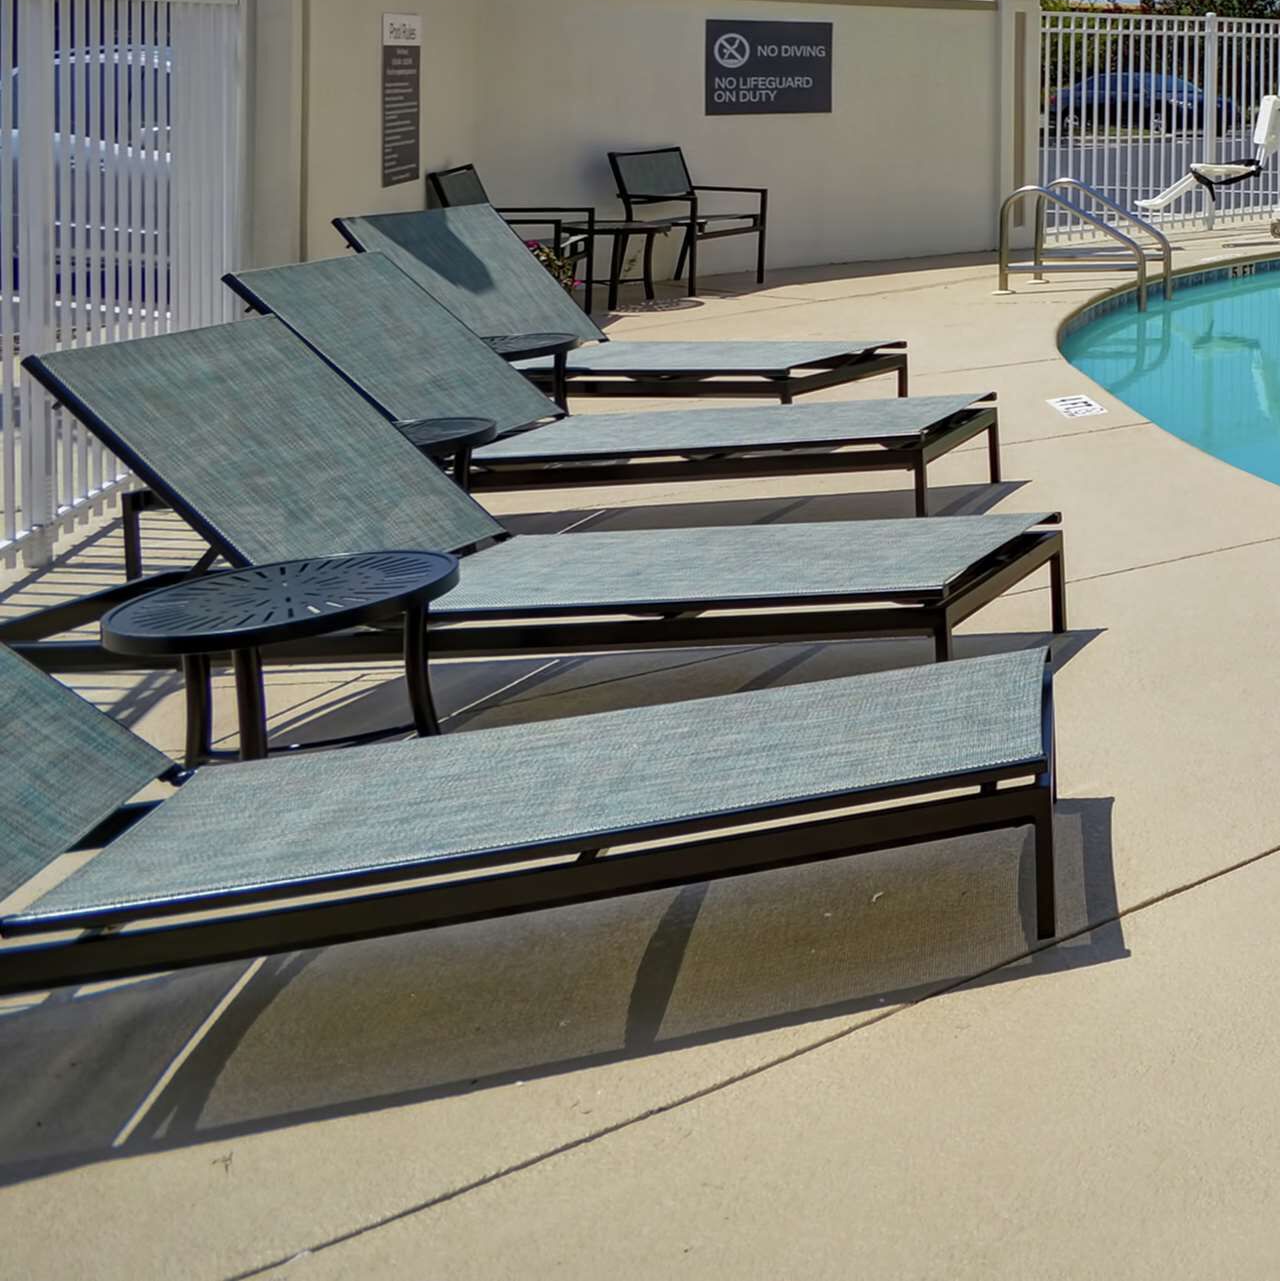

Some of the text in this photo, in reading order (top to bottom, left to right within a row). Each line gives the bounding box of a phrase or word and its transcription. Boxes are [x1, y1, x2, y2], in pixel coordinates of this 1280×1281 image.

[757, 45, 826, 57] NO DIVING
[714, 76, 814, 89] NO LIFEGUARD
[714, 90, 778, 103] ON DUTY
